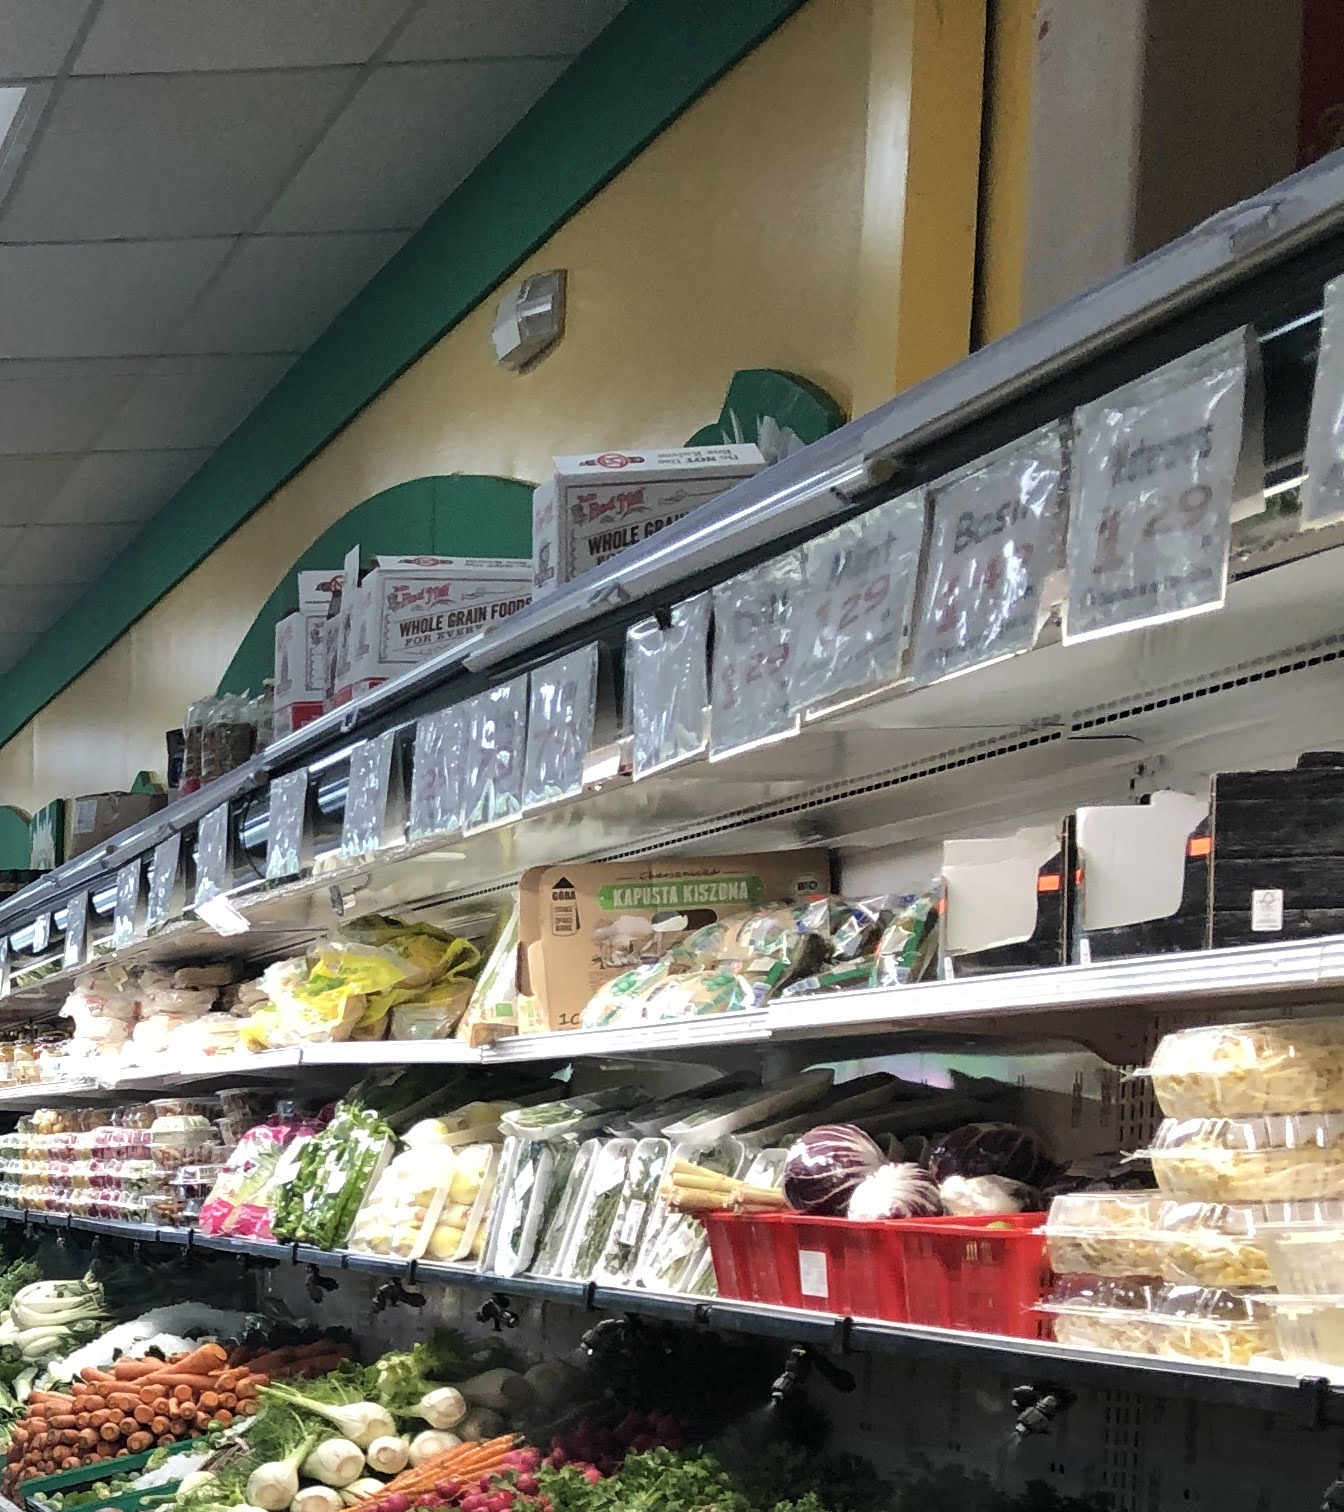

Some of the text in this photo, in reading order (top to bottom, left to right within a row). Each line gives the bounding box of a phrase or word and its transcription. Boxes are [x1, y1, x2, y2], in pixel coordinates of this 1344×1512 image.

[399, 613, 444, 638] WHOLE
[447, 606, 488, 629] GRAIN
[612, 881, 749, 907] KAPUSTA KISZONA
